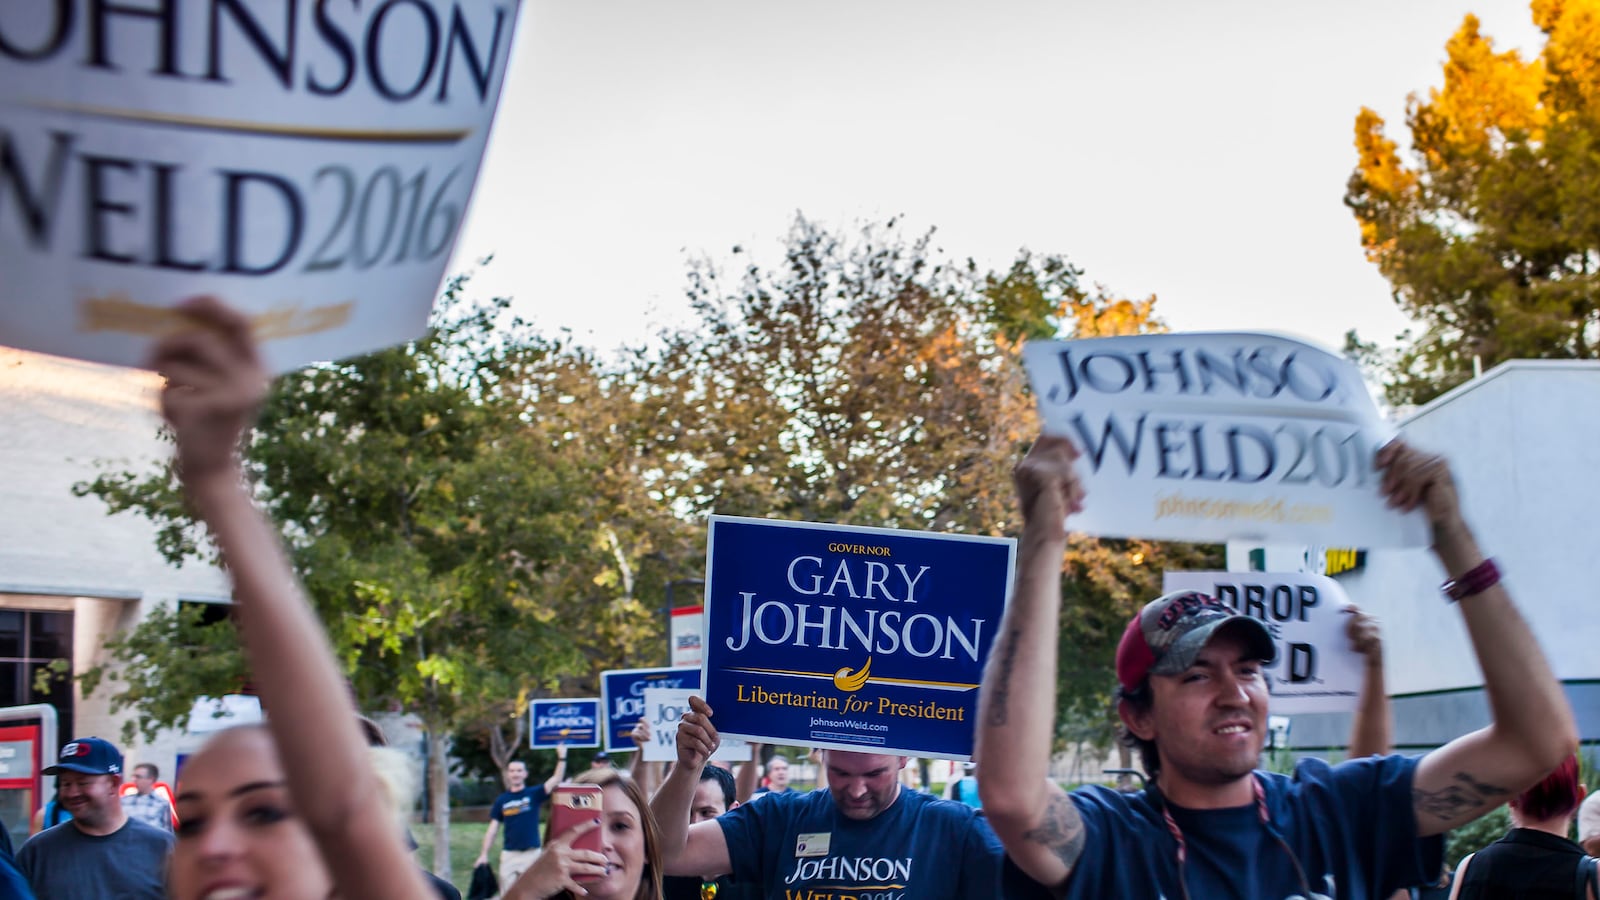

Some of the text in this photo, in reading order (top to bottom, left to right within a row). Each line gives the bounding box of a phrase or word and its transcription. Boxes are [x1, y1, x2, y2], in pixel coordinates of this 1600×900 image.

[828, 542, 891, 557] GOVERNOR
[786, 555, 931, 603] GARY
[725, 591, 986, 662] JOHNSON
[736, 684, 965, 722] Libertarian for President
[809, 716, 889, 732] JohnsonWeld.com
[784, 855, 913, 885] JOHNSON
